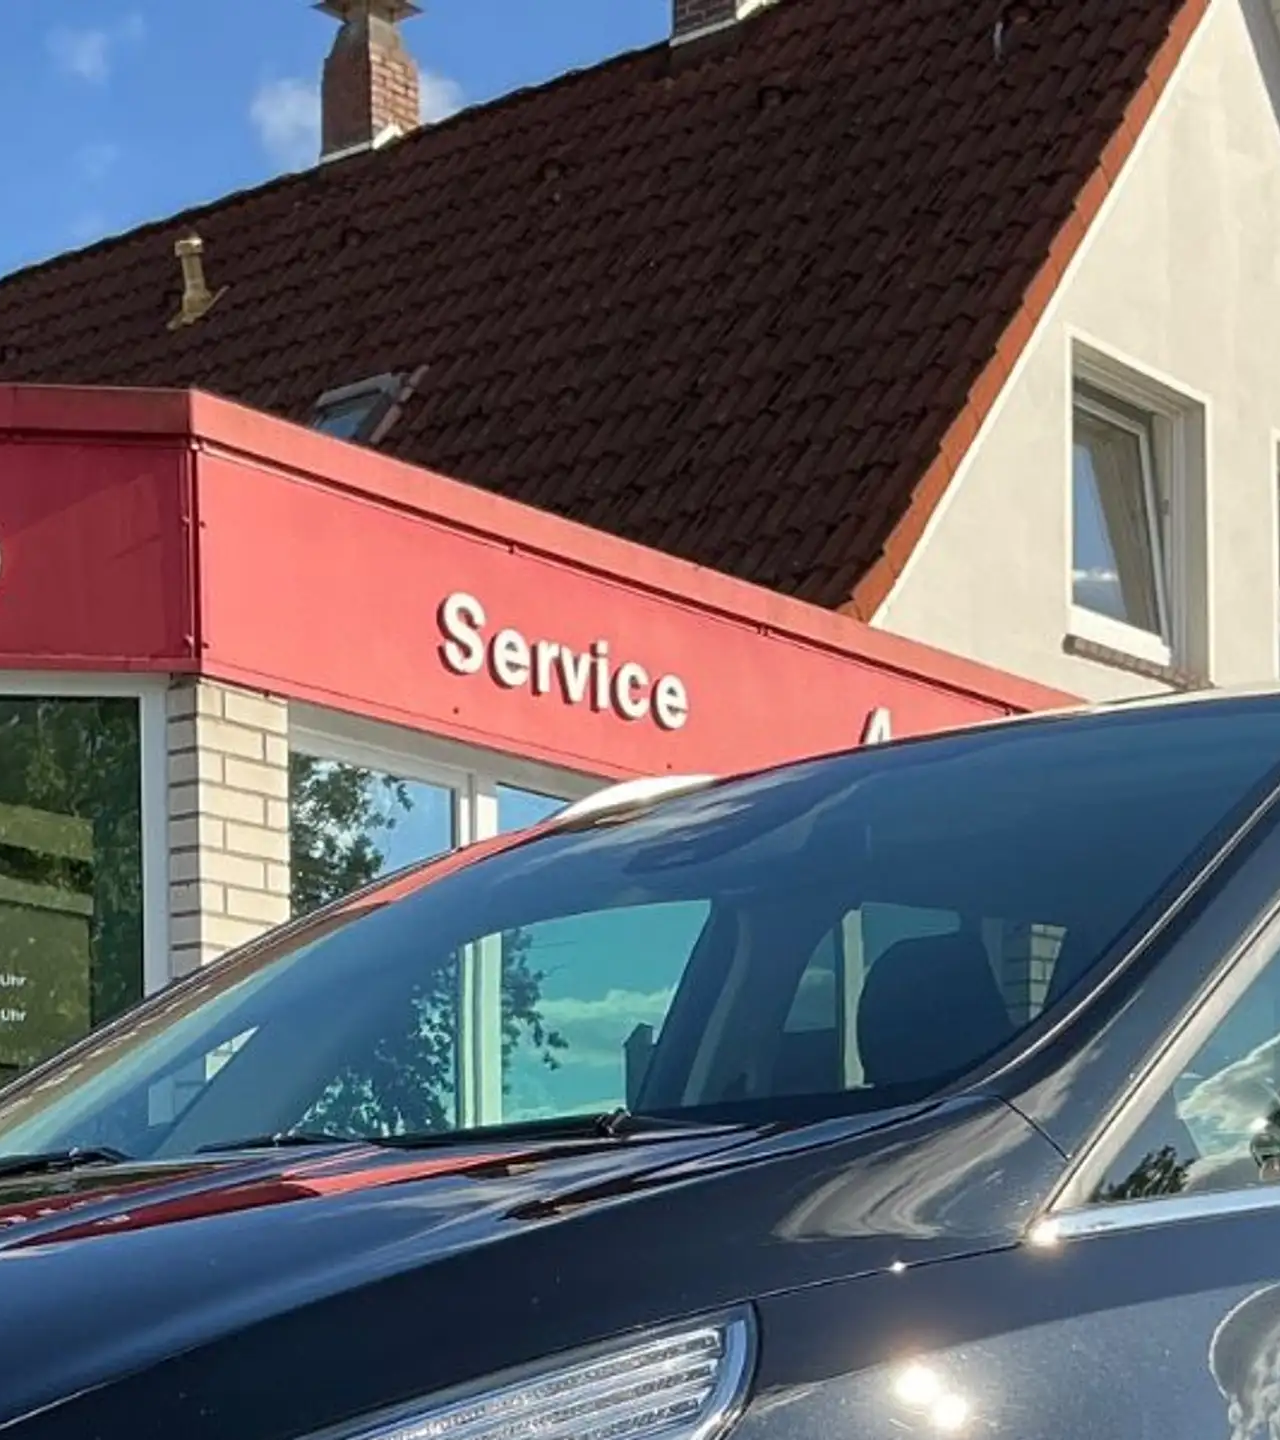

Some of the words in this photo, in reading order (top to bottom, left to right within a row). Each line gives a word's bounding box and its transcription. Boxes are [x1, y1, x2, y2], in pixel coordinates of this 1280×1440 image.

[437, 591, 689, 730] Service
[0, 973, 27, 986] Uhr
[0, 1008, 27, 1021] Uhr
